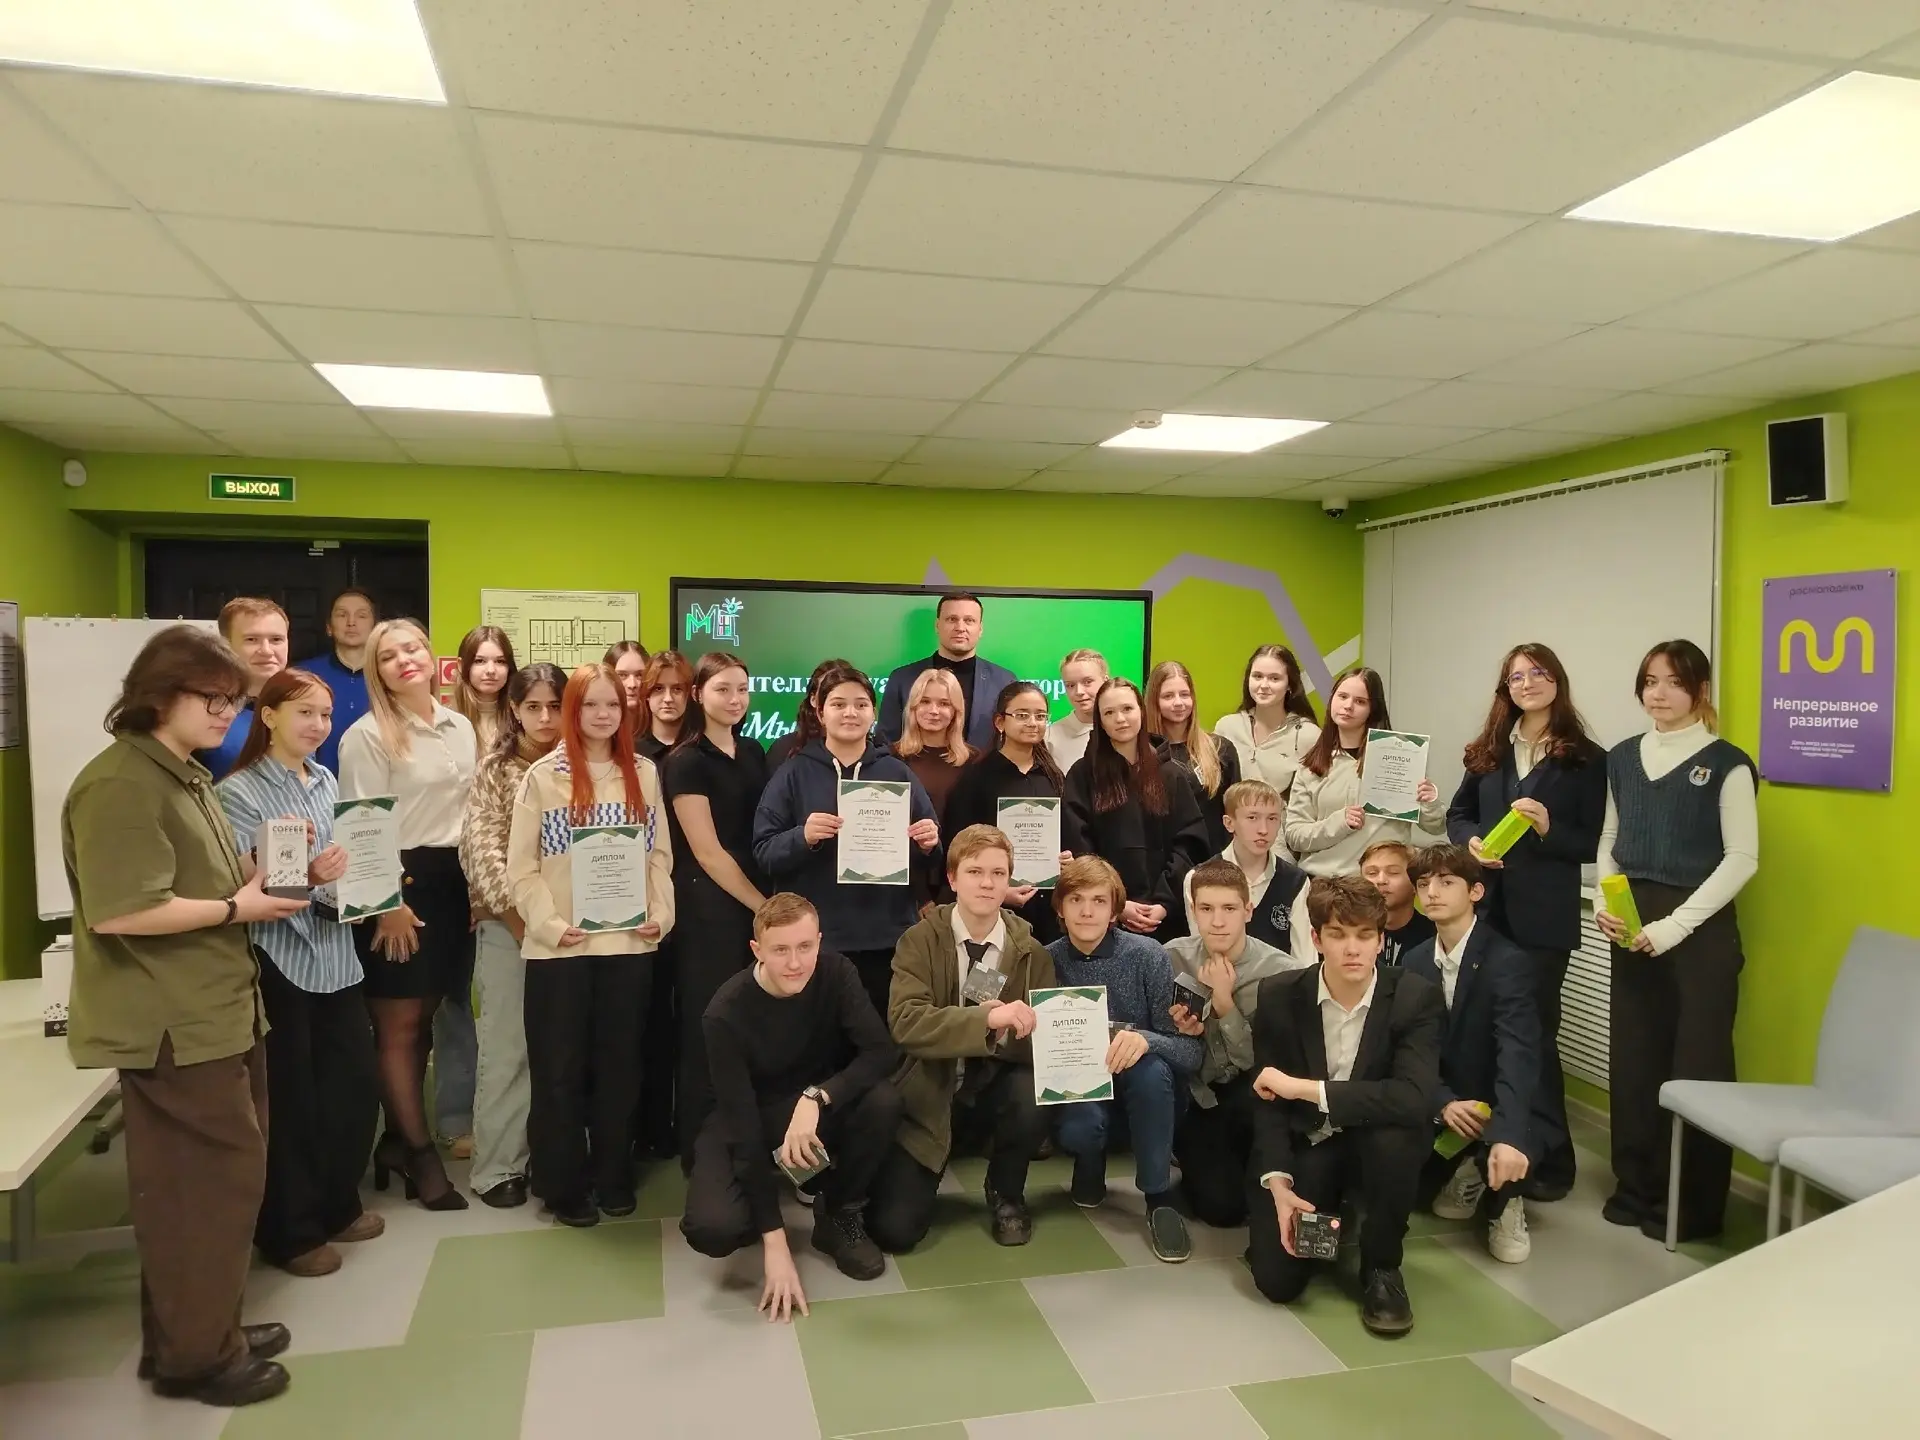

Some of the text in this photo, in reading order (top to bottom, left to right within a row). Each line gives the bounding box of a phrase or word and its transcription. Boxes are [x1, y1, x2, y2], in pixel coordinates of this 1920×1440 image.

[225, 481, 280, 497] ВЫХОД
[1773, 697, 1879, 714] Непрерывное
[1789, 715, 1859, 729] развитие
[858, 808, 891, 816] ДИПЛОМ
[591, 853, 625, 863] ДИПЛОМ
[1052, 1018, 1087, 1028] ДИПЛОМ
